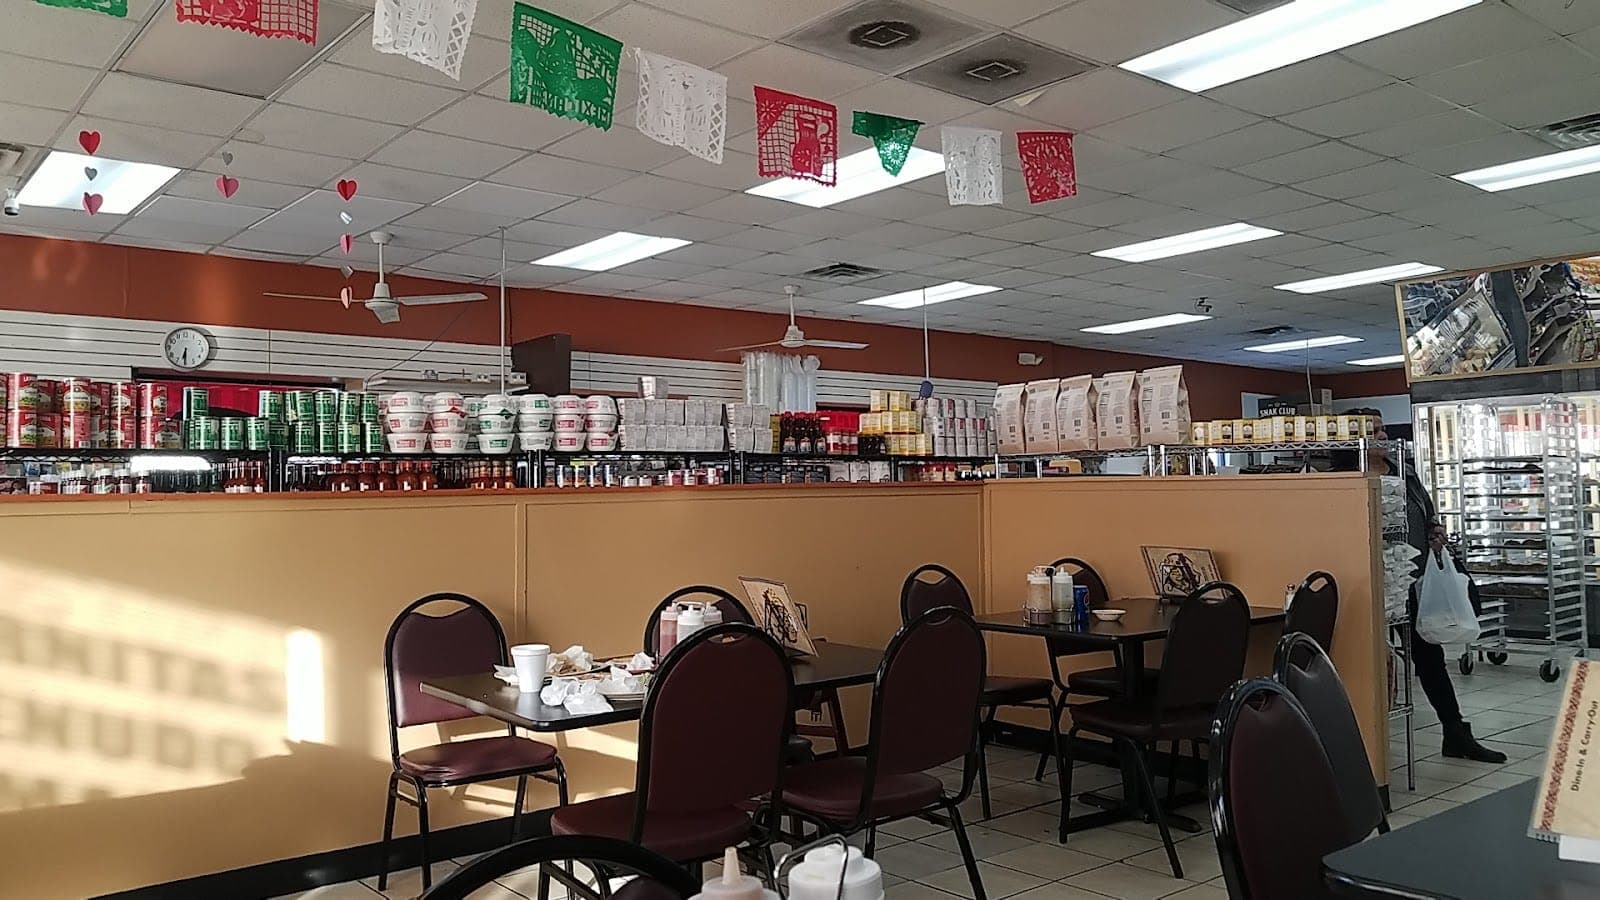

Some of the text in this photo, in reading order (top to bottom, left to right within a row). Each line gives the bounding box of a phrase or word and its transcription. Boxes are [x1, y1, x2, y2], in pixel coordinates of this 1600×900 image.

[1259, 408, 1277, 417] SNAK
[1570, 758, 1585, 792] Dine-In
[1580, 700, 1599, 745] Carry-Out
